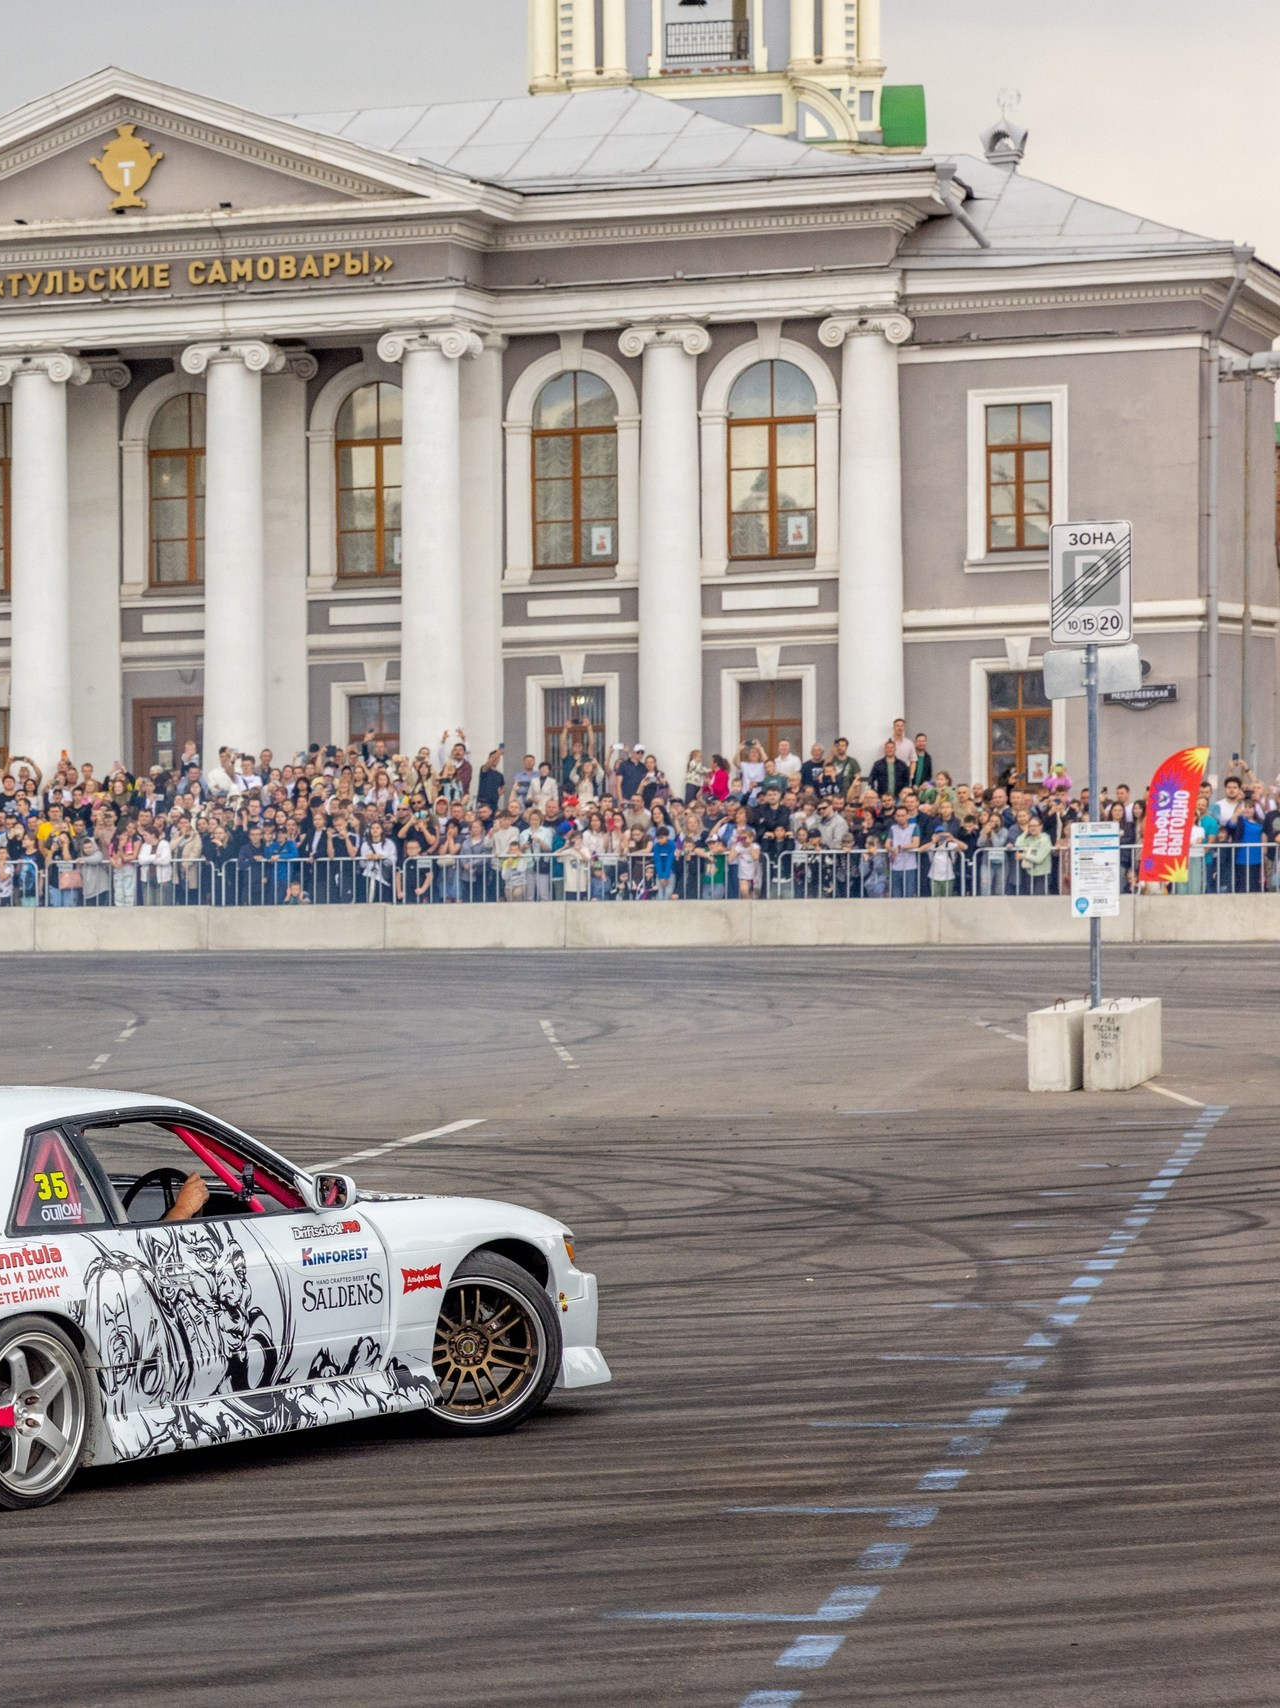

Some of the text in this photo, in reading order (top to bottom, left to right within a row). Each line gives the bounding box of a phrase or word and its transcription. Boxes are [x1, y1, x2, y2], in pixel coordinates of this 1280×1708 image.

[188, 250, 393, 285] САМОВАРЫ»
[1068, 532, 1116, 546] ЗОНА
[1067, 615, 1120, 631] 10 15 20
[1152, 808, 1171, 856] АЛЬФА
[1167, 790, 1190, 856] ВЫГОДНО
[34, 1171, 69, 1200] 35
[302, 1247, 368, 1266] KINFOREST
[14, 1271, 24, 1283] И
[27, 1266, 69, 1284] ДИСКИ
[330, 1276, 351, 1284] CRAFTED
